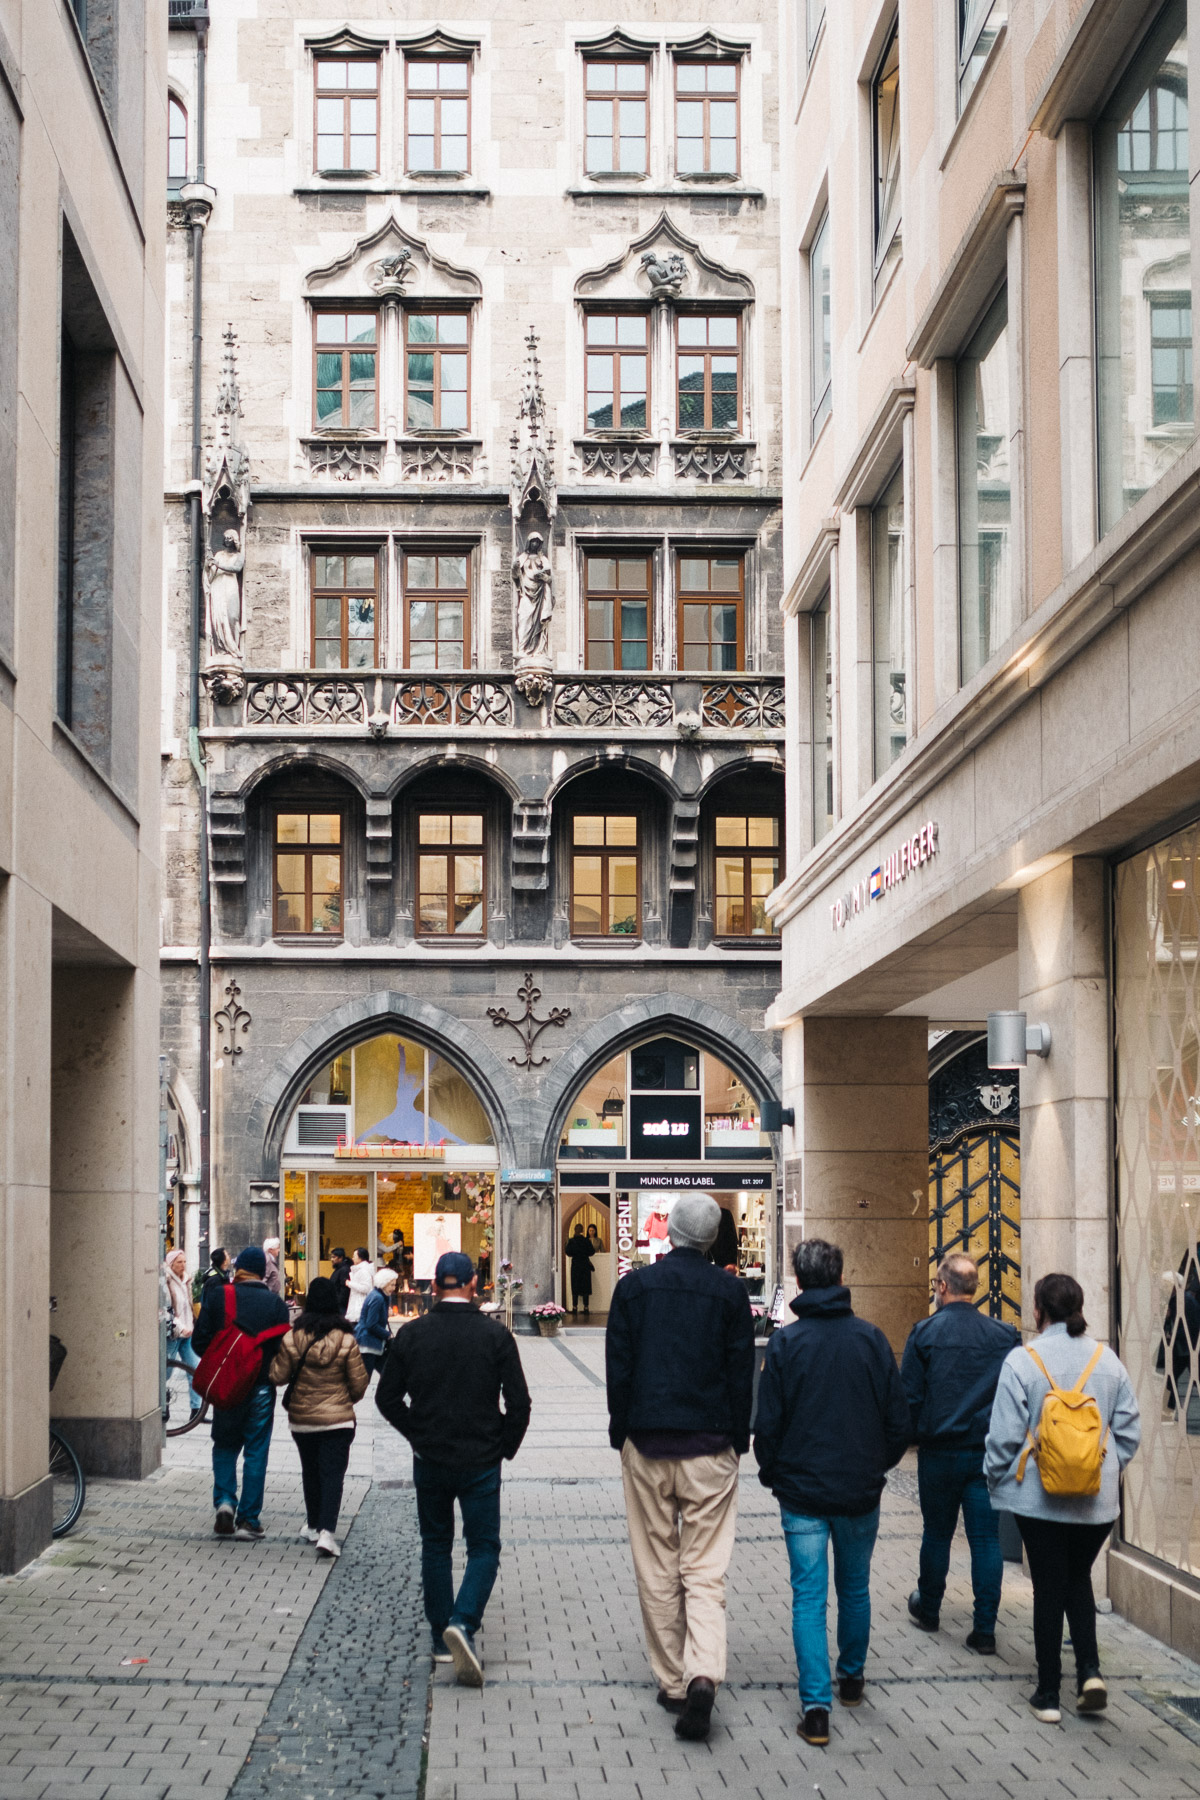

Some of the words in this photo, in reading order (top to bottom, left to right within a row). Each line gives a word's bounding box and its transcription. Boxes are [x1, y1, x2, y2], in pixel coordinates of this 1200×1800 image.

[883, 821, 938, 890] HILFIGER
[671, 1123, 690, 1135] LU
[640, 1177, 672, 1185] MUNICH
[674, 1177, 690, 1185] BAG
[692, 1177, 715, 1185] LABEL
[618, 1200, 632, 1251] OPEN!
